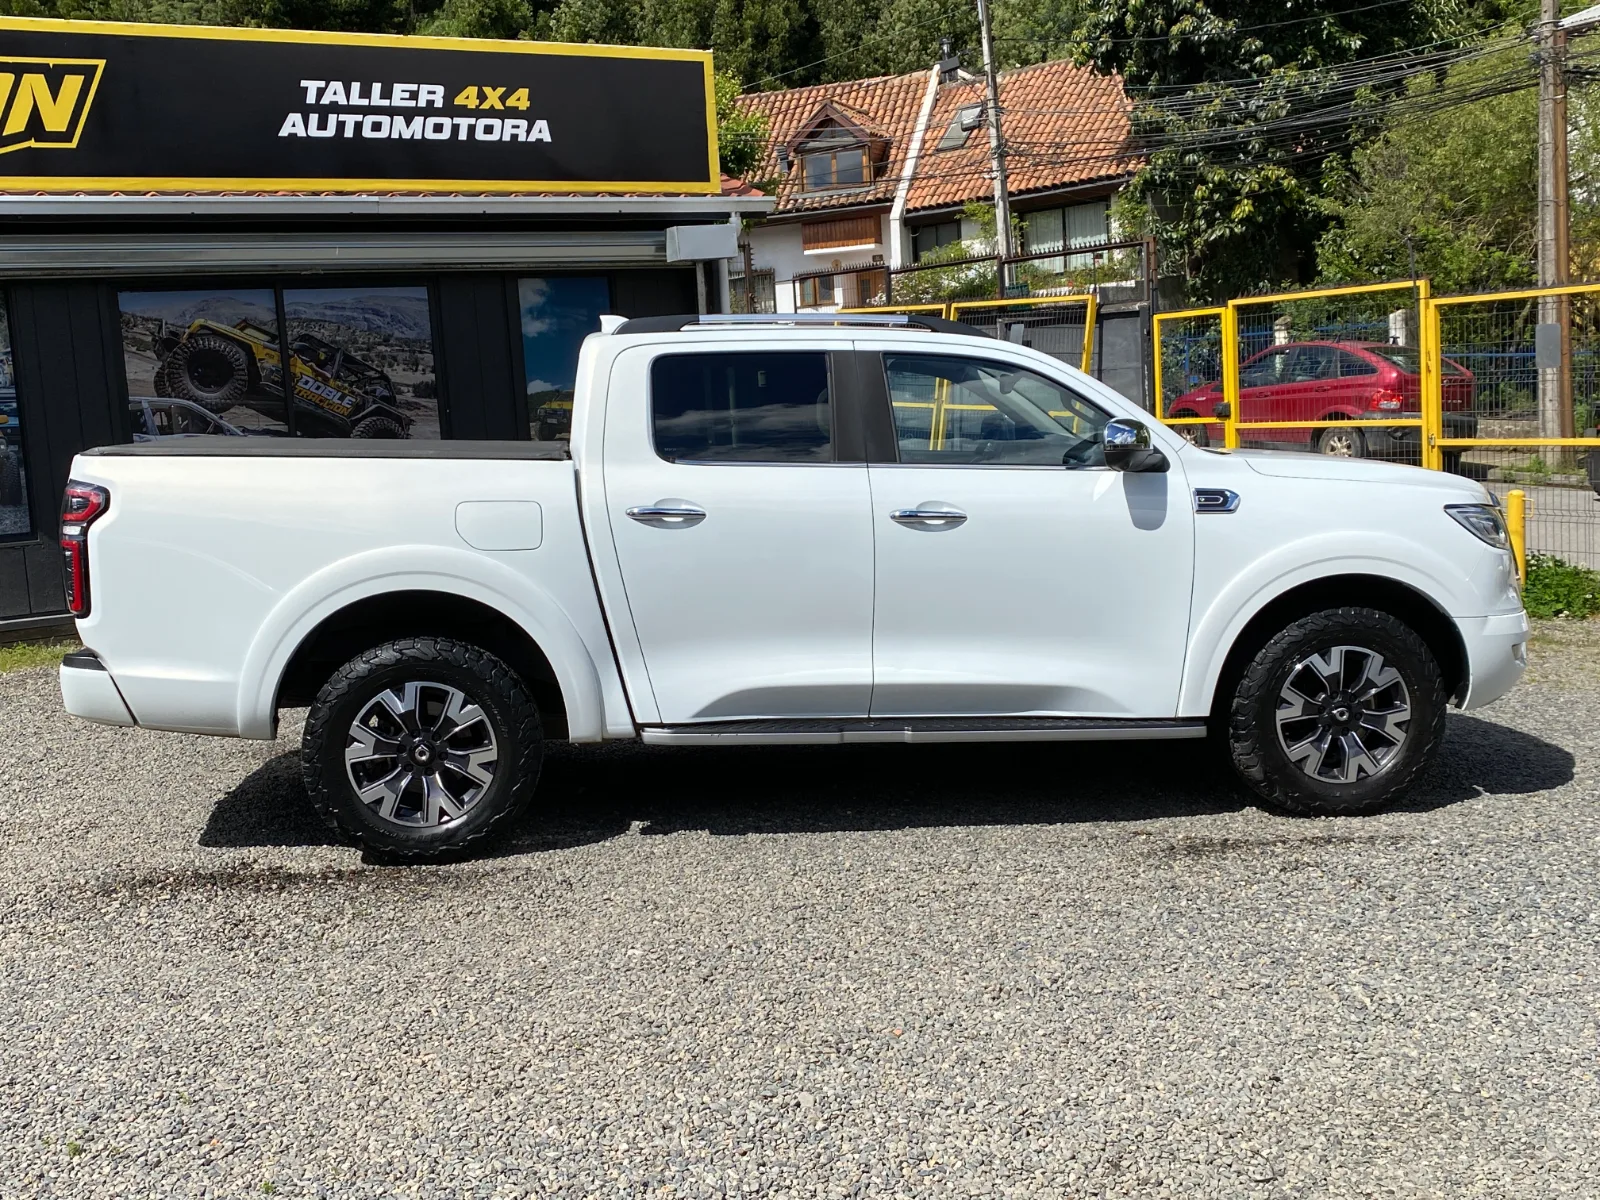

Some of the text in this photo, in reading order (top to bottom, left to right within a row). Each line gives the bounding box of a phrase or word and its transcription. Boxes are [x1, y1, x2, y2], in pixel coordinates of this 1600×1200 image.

[300, 79, 531, 111] TALLER 4X4
[278, 112, 552, 143] AUTOMOTORA
[298, 375, 356, 407] DOBLE
